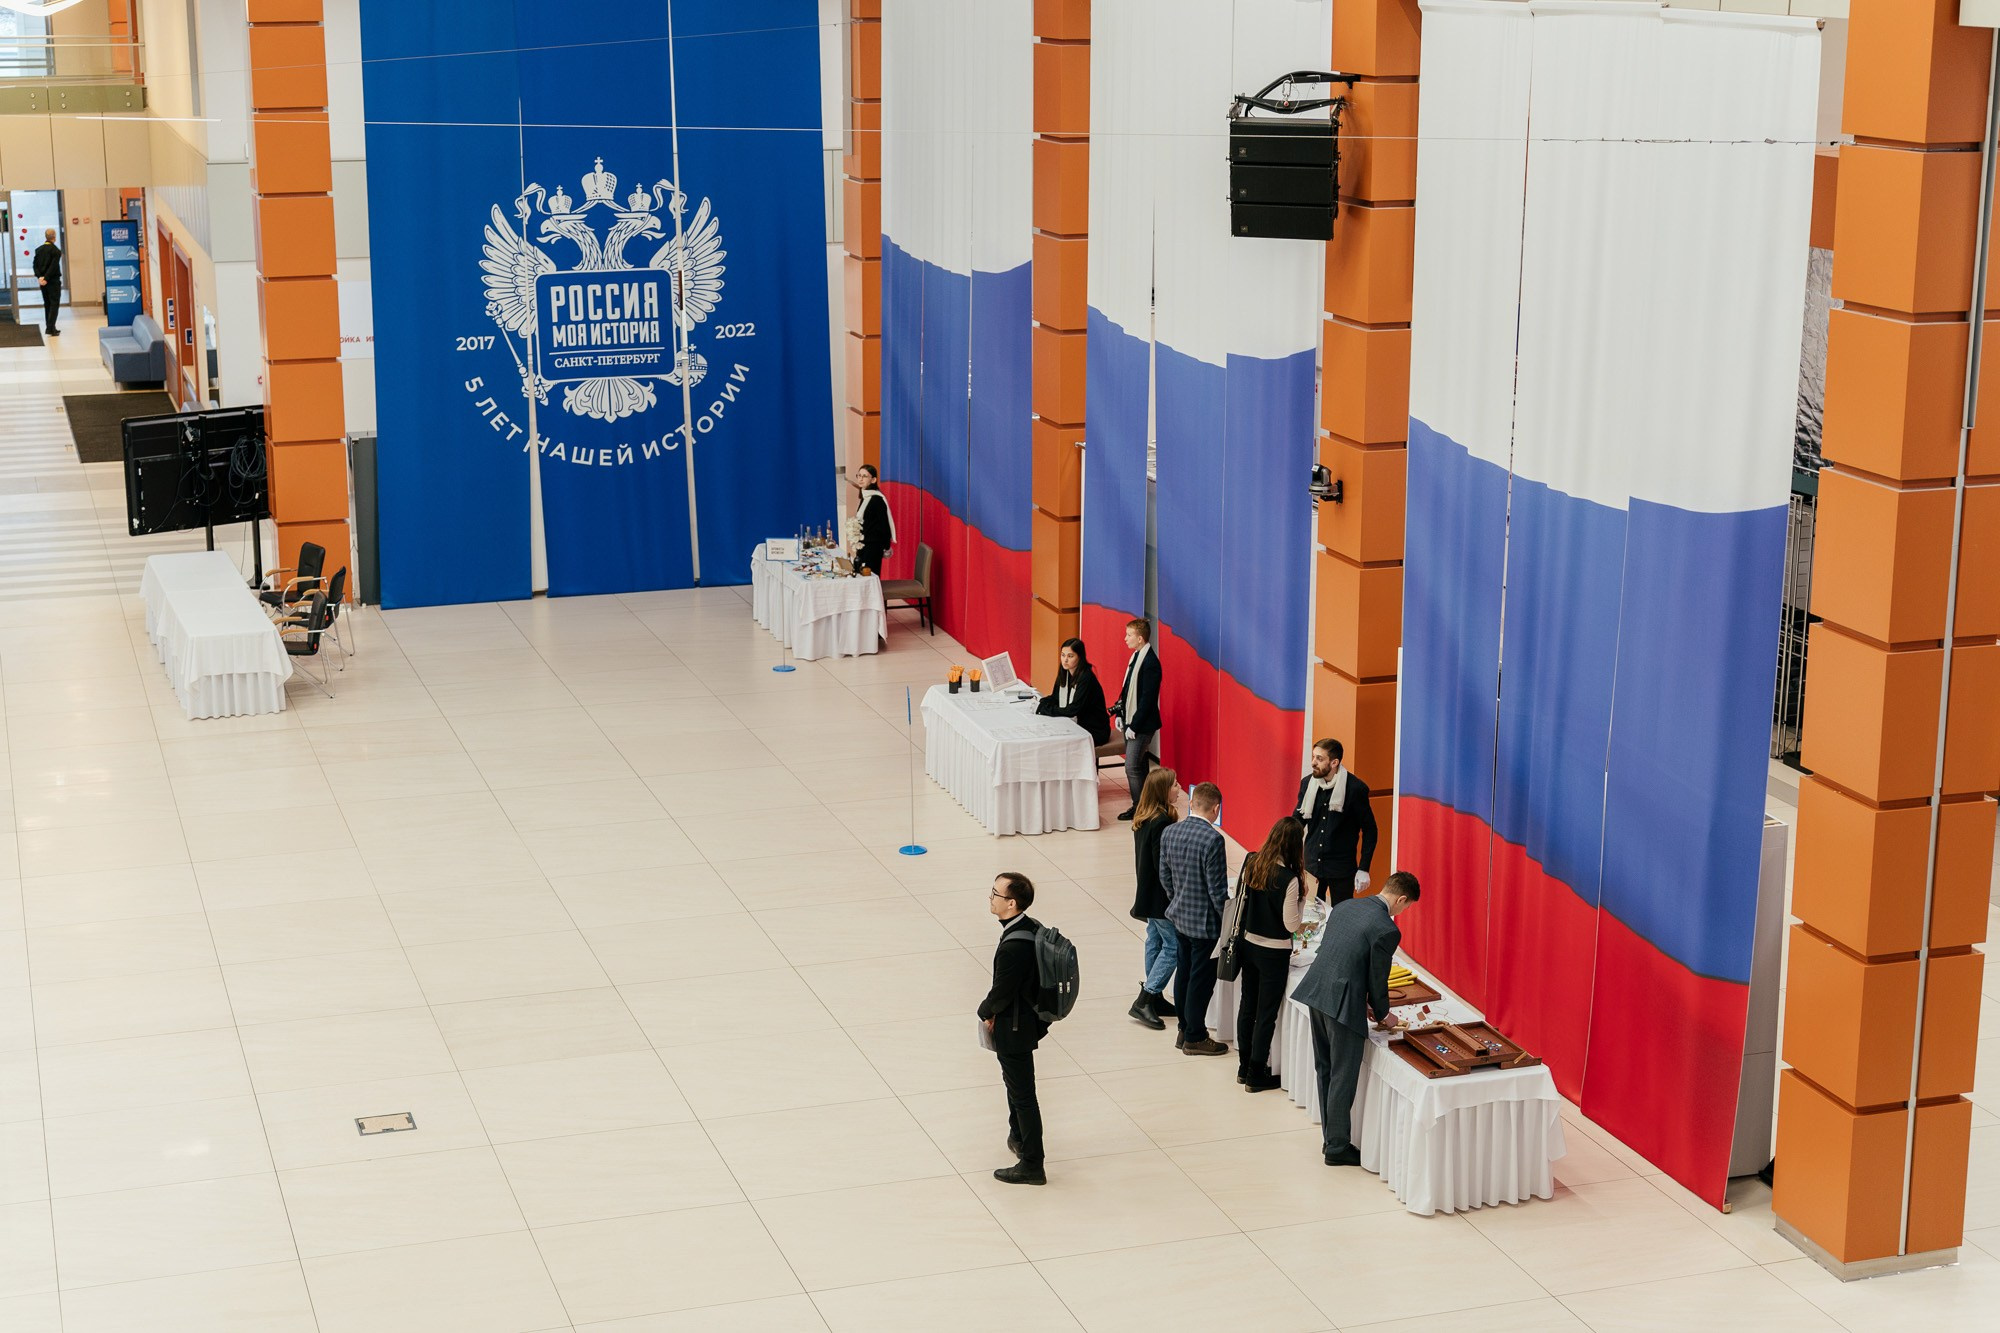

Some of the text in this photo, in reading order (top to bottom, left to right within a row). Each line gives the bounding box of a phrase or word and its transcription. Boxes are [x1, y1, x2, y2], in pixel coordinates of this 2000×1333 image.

[550, 282, 659, 323] РОССИЯ
[339, 334, 361, 344] ОЙКА
[552, 321, 660, 348] МОЯ ИСТОРИЯ
[714, 322, 757, 340] 2022
[455, 335, 496, 352] 2017
[554, 353, 661, 369] САНКТ-ПЕТЕРБУРГ
[465, 362, 751, 467] 5 ЛЕТ НАШЕЙ ИСТОРИИ
